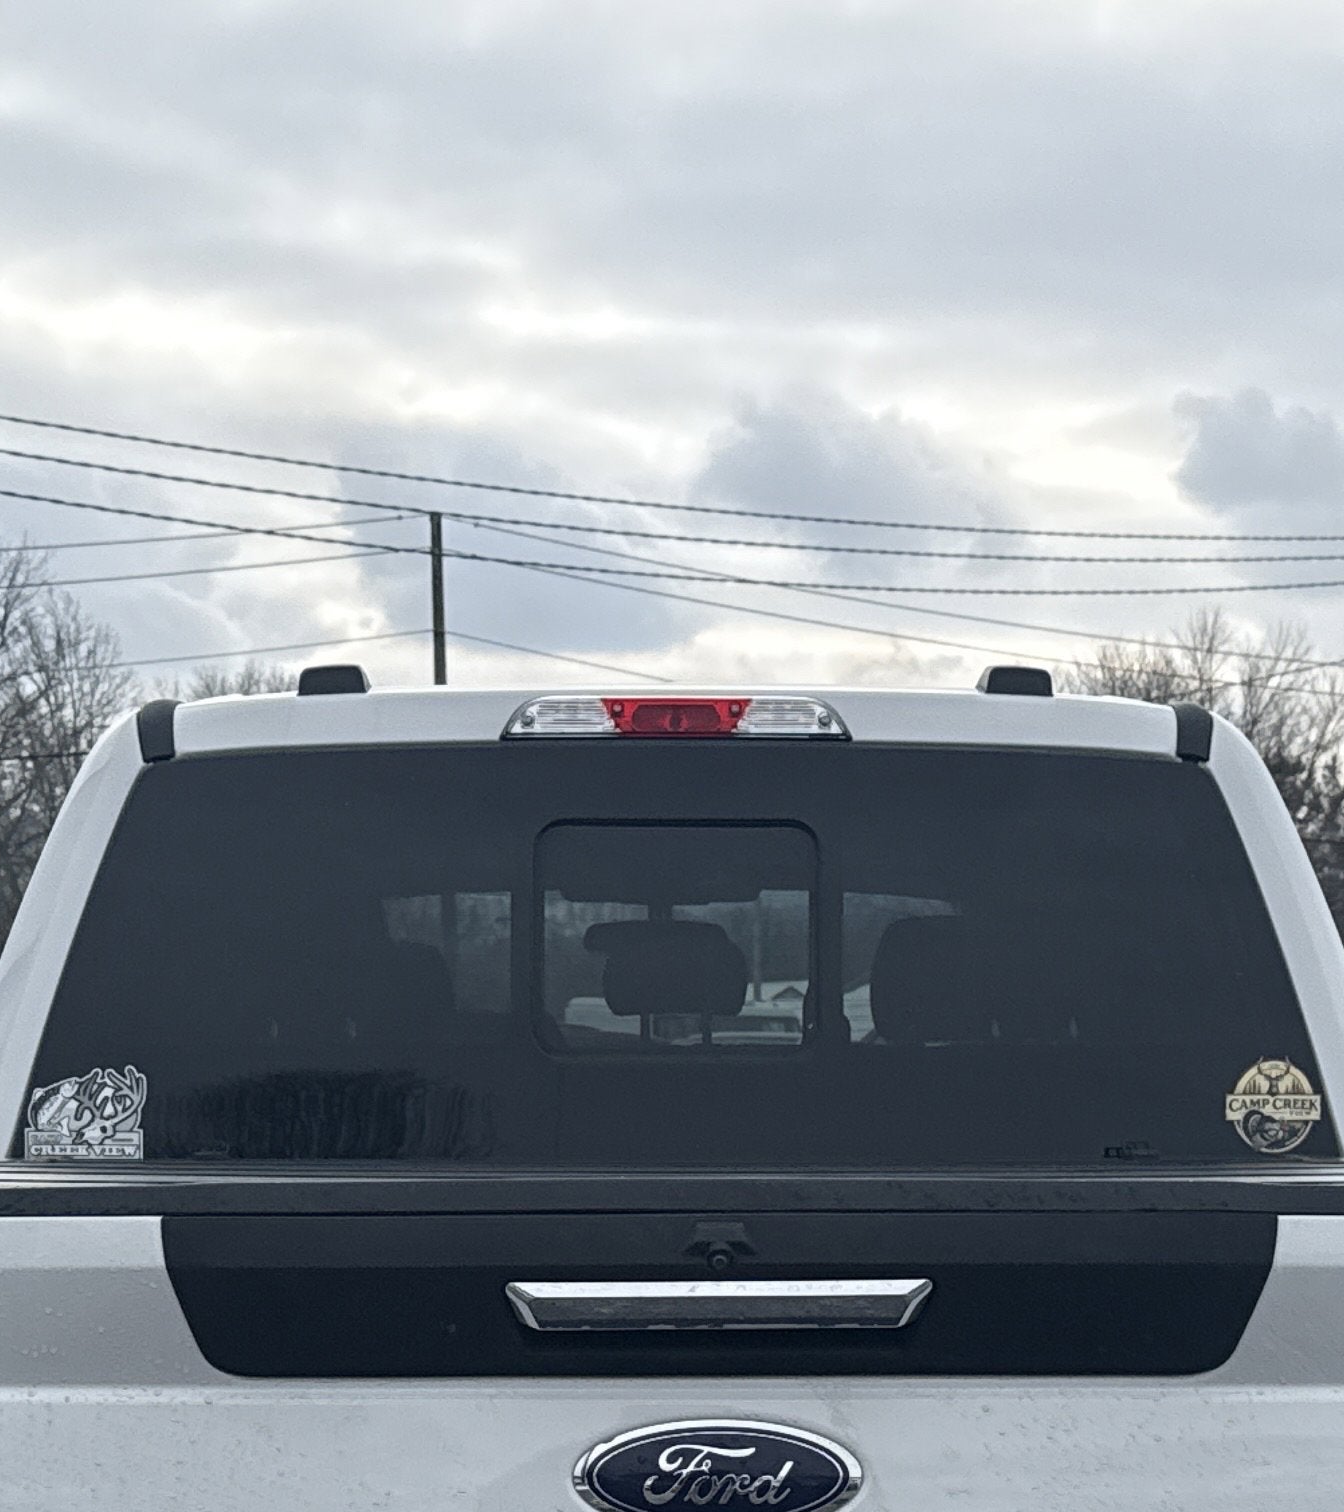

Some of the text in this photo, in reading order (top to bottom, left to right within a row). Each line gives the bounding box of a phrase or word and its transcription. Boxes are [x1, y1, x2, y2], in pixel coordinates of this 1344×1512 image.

[1228, 1098, 1318, 1112] CAMP CREEK
[30, 1144, 137, 1156] CREEK VIEW
[643, 1444, 795, 1506] Ford
